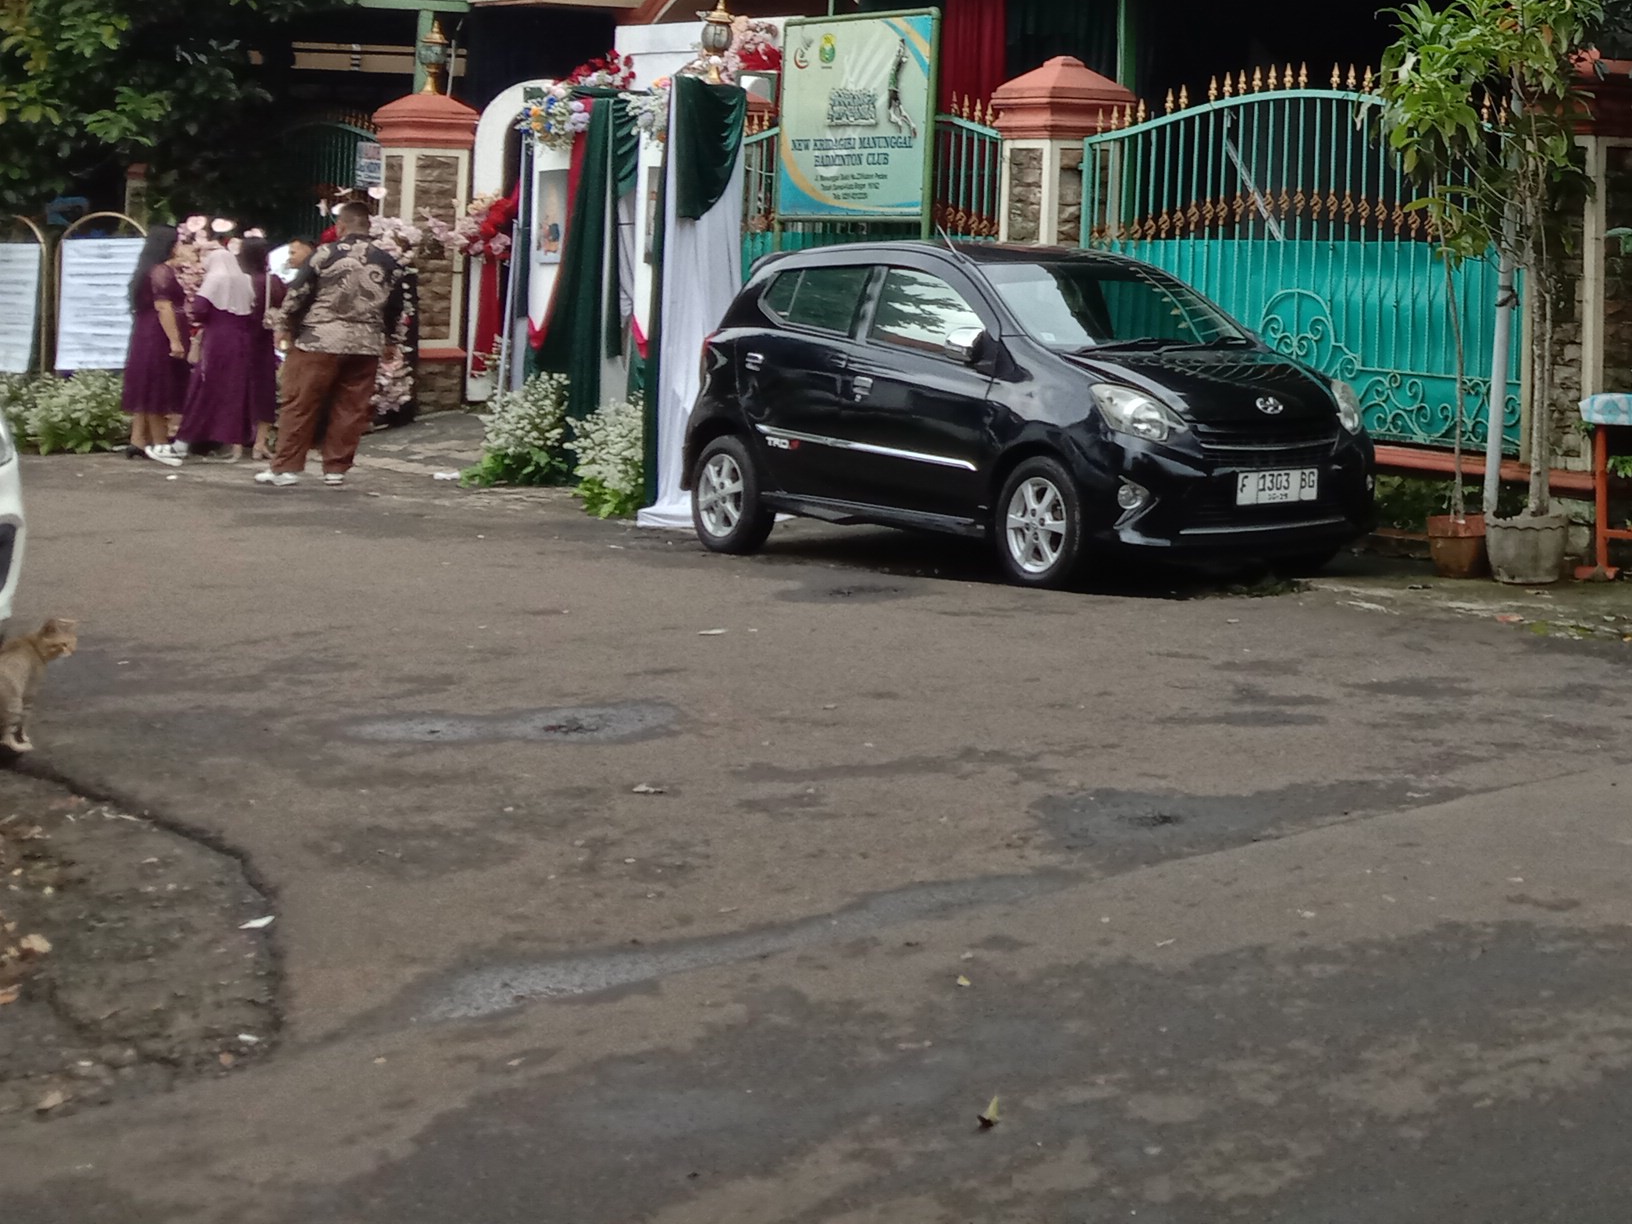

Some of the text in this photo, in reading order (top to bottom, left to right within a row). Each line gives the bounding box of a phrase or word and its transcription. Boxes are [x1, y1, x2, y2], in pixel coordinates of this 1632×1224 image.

[791, 139, 810, 151] NEW
[814, 153, 889, 167] BADMINTON CLUB
[1240, 471, 1316, 493] F 1303 BG
